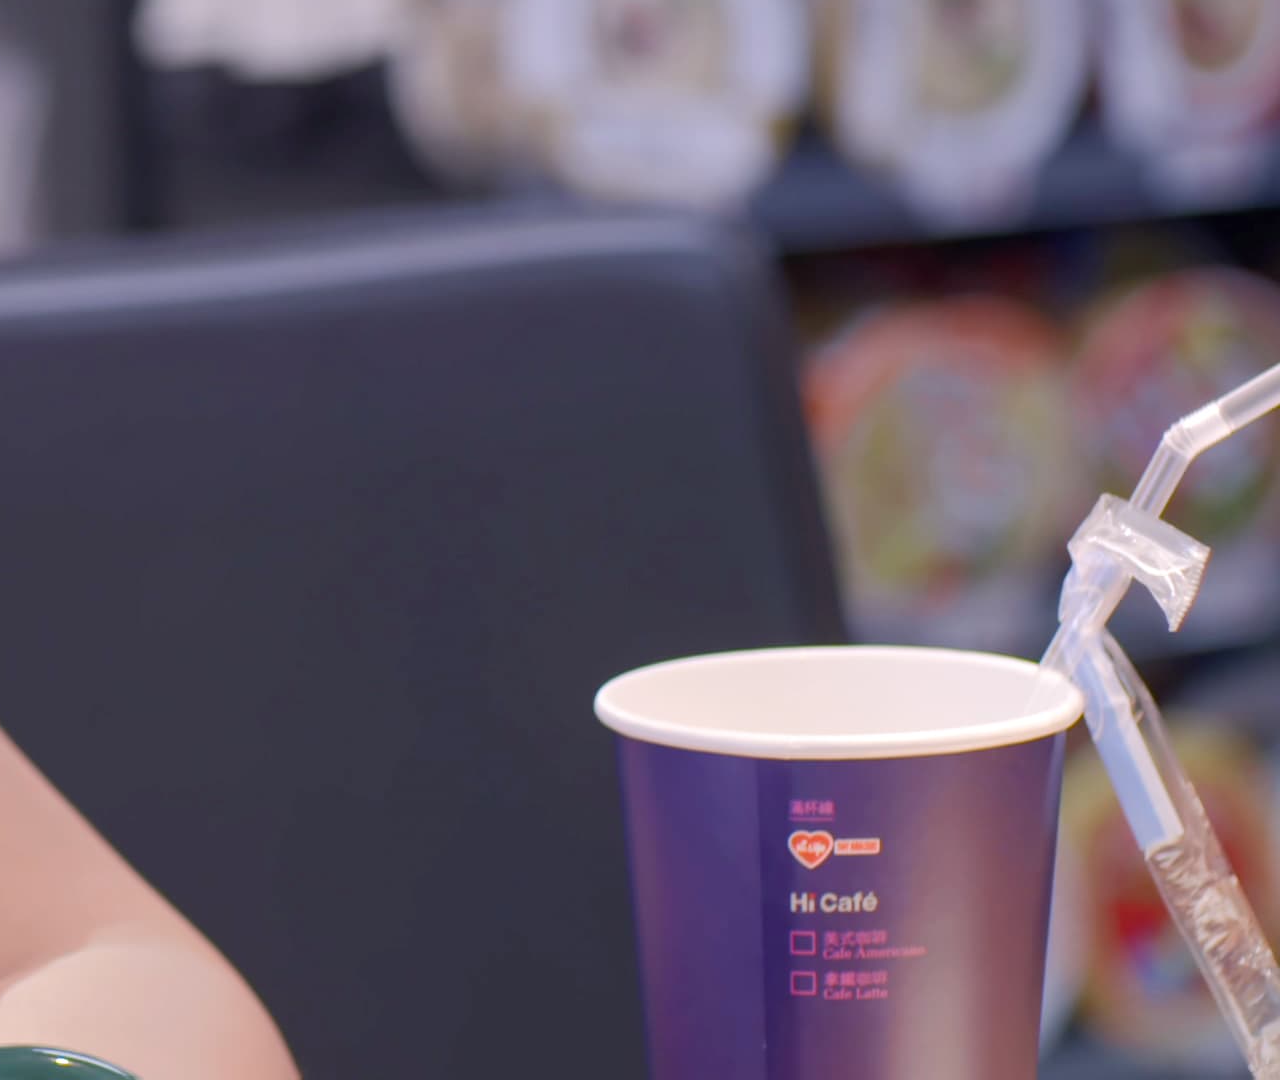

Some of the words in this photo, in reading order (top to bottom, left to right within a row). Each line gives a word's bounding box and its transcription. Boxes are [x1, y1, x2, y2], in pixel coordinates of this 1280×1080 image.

[790, 892, 816, 913] Hi
[820, 891, 878, 913] Café
[856, 986, 889, 1001] Latte
